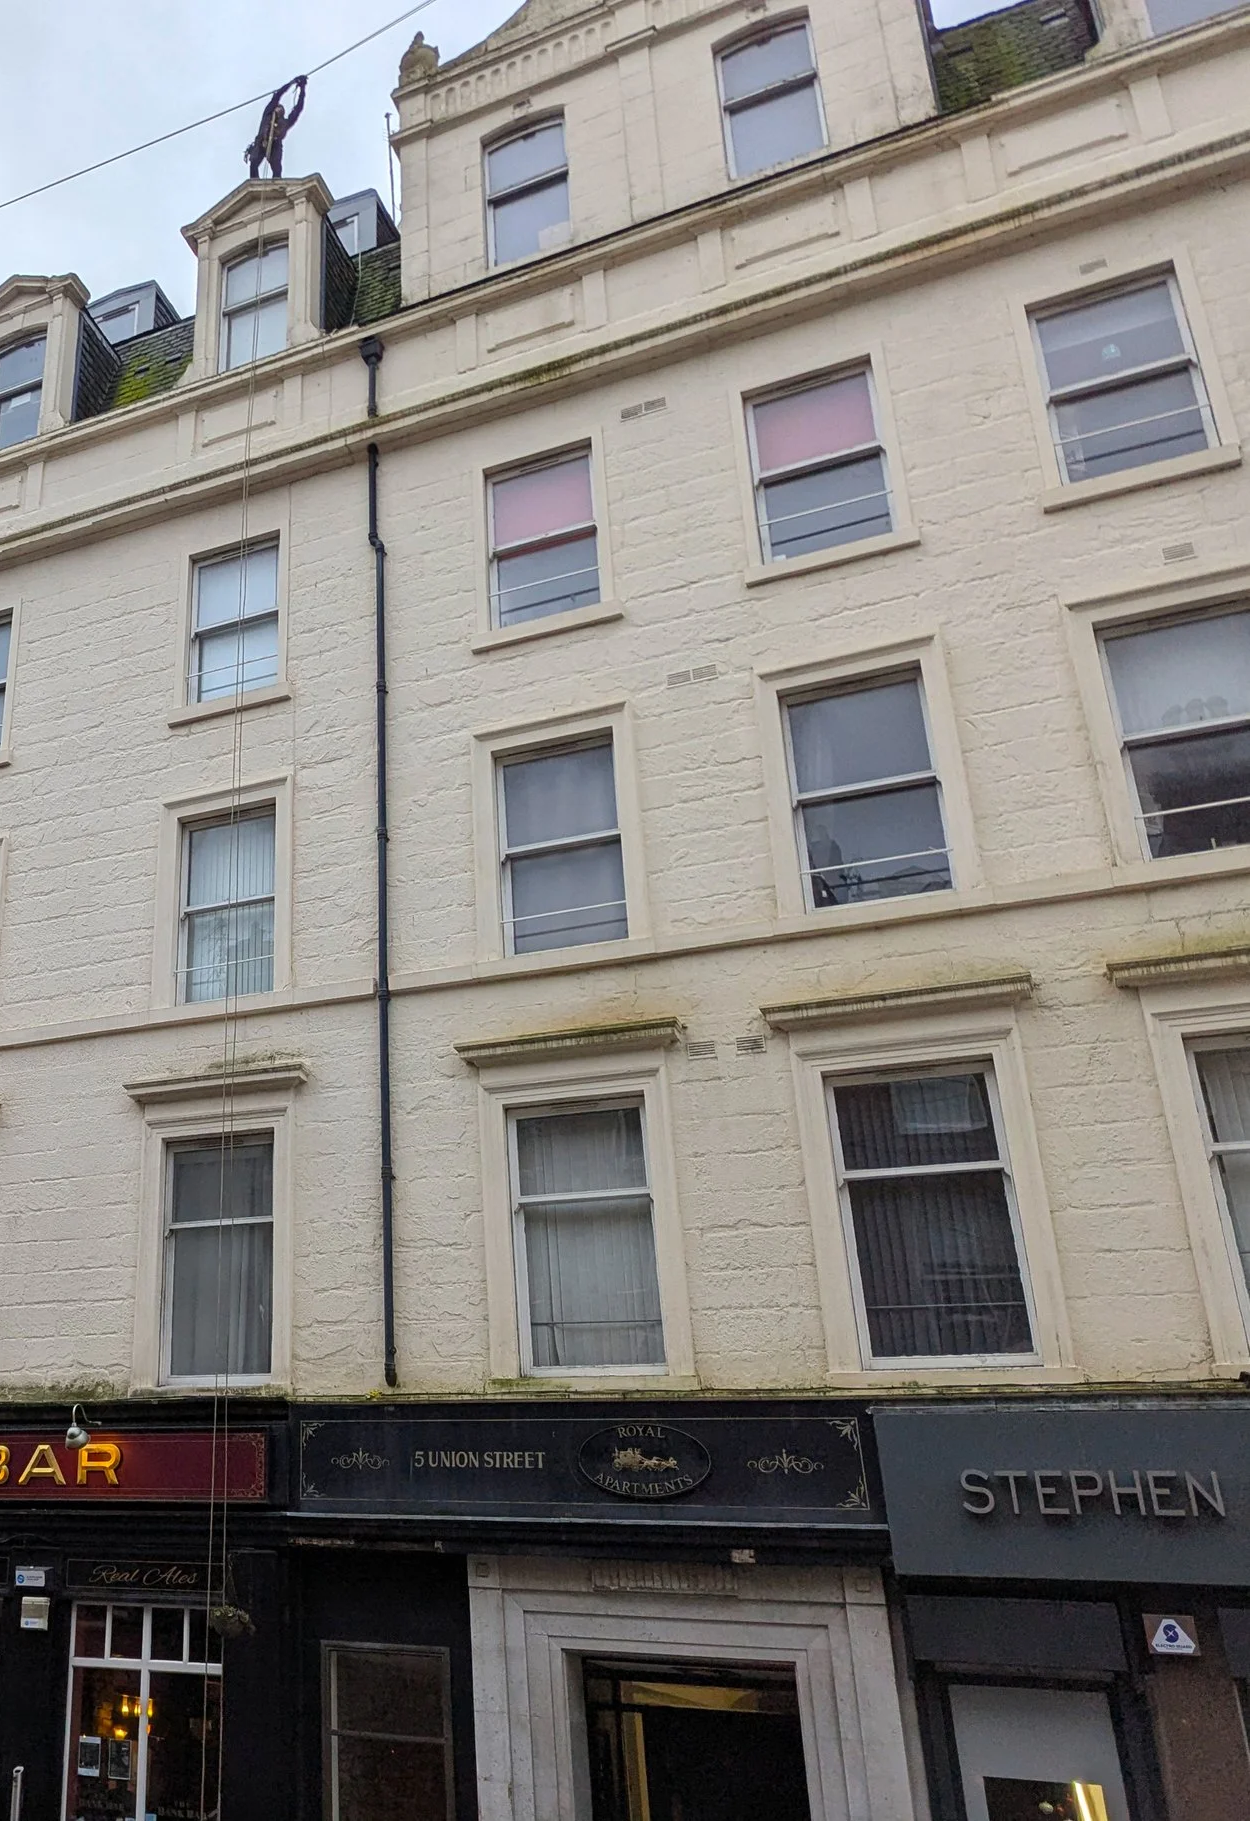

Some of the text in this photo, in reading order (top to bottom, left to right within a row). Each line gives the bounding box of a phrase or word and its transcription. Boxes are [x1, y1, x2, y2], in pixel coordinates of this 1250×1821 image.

[617, 1425, 665, 1438] ROYAL
[414, 1451, 545, 1468] 5 UNION STREET
[594, 1472, 693, 1495] APARTMENTS
[960, 1469, 1227, 1518] STEPHEN
[89, 1565, 197, 1585] Real Ales
